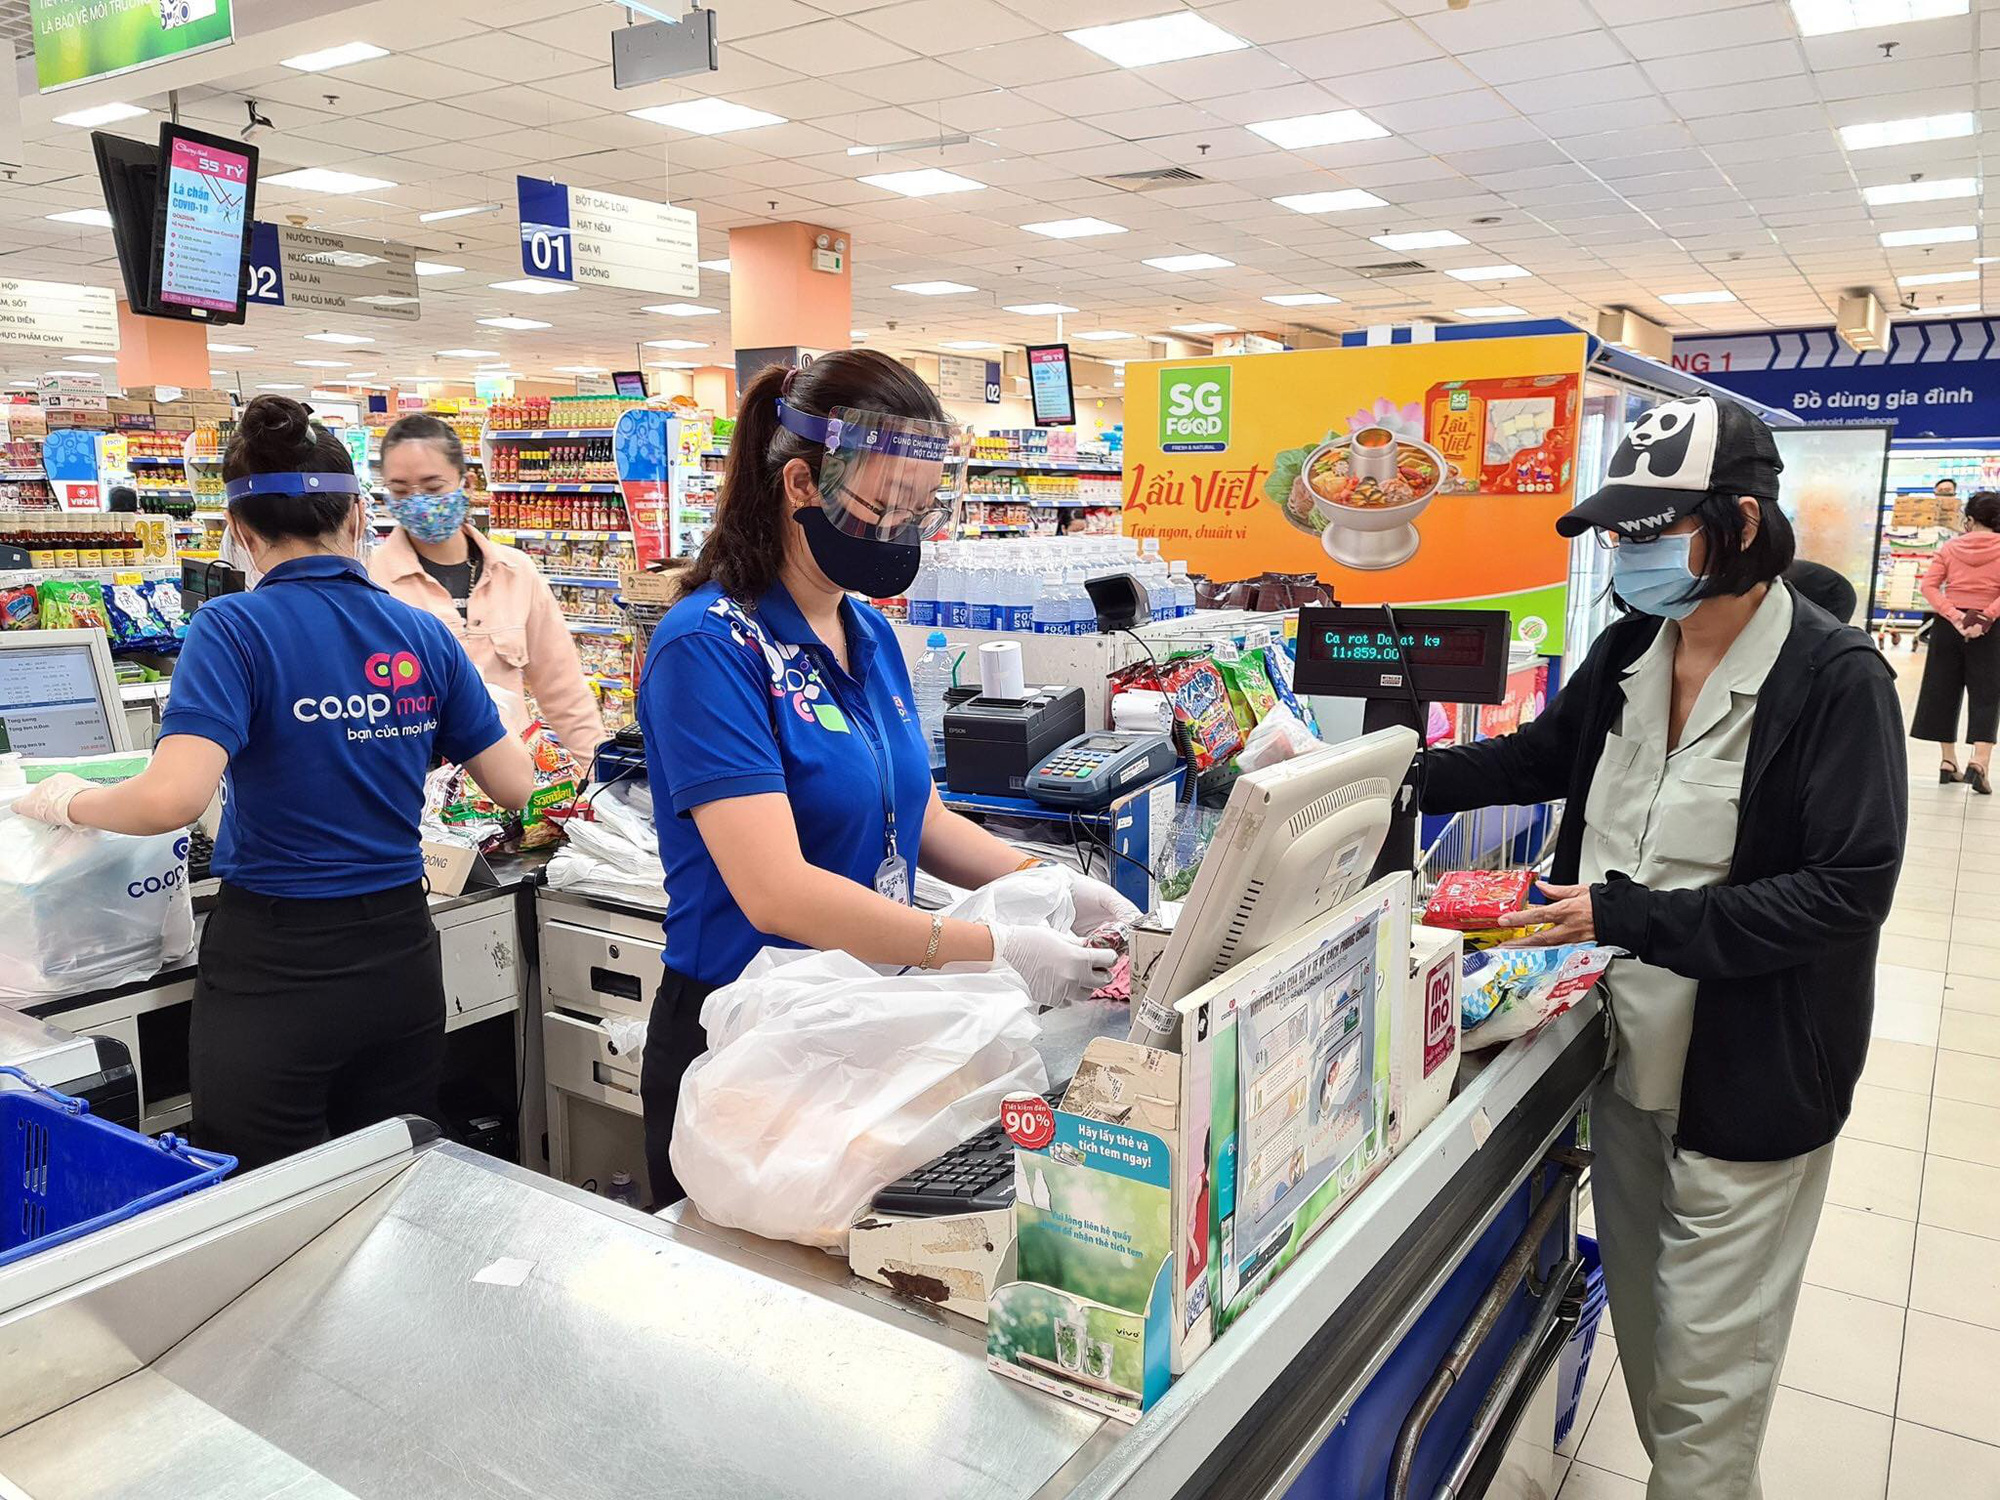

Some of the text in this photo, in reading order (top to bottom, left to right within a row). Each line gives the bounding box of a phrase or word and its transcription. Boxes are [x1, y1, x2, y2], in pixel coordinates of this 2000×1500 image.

[88, 3, 108, 21] MÔI
[198, 157, 220, 172] 55
[172, 197, 209, 214] COVID-19
[286, 231, 344, 249] NƯỚC TƯƠNG
[578, 243, 592, 254] GIA
[287, 253, 314, 264] NƯỚC
[531, 231, 566, 273] 01
[579, 264, 610, 279] ĐƯỜNG
[291, 293, 309, 303] RAU
[42, 335, 64, 343] CHAY
[986, 384, 1000, 401] 02
[1167, 381, 1223, 416] SG
[1792, 386, 1974, 411] Đồ dùng gia đình
[1166, 416, 1223, 437] FOOD
[1124, 463, 1270, 516] Lẩu Việt
[71, 497, 98, 507] VIFON
[1617, 510, 1676, 532] WWF
[1158, 528, 1193, 541] ngon,
[1324, 631, 1341, 644] Ca
[1347, 634, 1369, 645] rot
[1424, 635, 1441, 648] kg
[1332, 647, 1400, 660] 11,859.00
[293, 693, 392, 724] co.op
[347, 728, 372, 743] bạn
[374, 724, 400, 738] của
[402, 721, 422, 737] mọi
[1005, 1103, 1017, 1111] Tiết
[1017, 1104, 1034, 1113] kiệm
[1005, 1111, 1050, 1134] 90%
[1078, 1124, 1149, 1152] Hãy lấy thẻ và
[1078, 1139, 1152, 1168] tích tem ngay!
[1064, 1213, 1083, 1229] lòng
[1084, 1219, 1099, 1233] liên
[1100, 1224, 1111, 1236] hệ
[1073, 1231, 1094, 1244] nhận
[1095, 1237, 1109, 1248] thẻ
[1110, 1241, 1126, 1254] tích
[1127, 1248, 1144, 1259] tem
[1115, 1327, 1139, 1339] vivo
